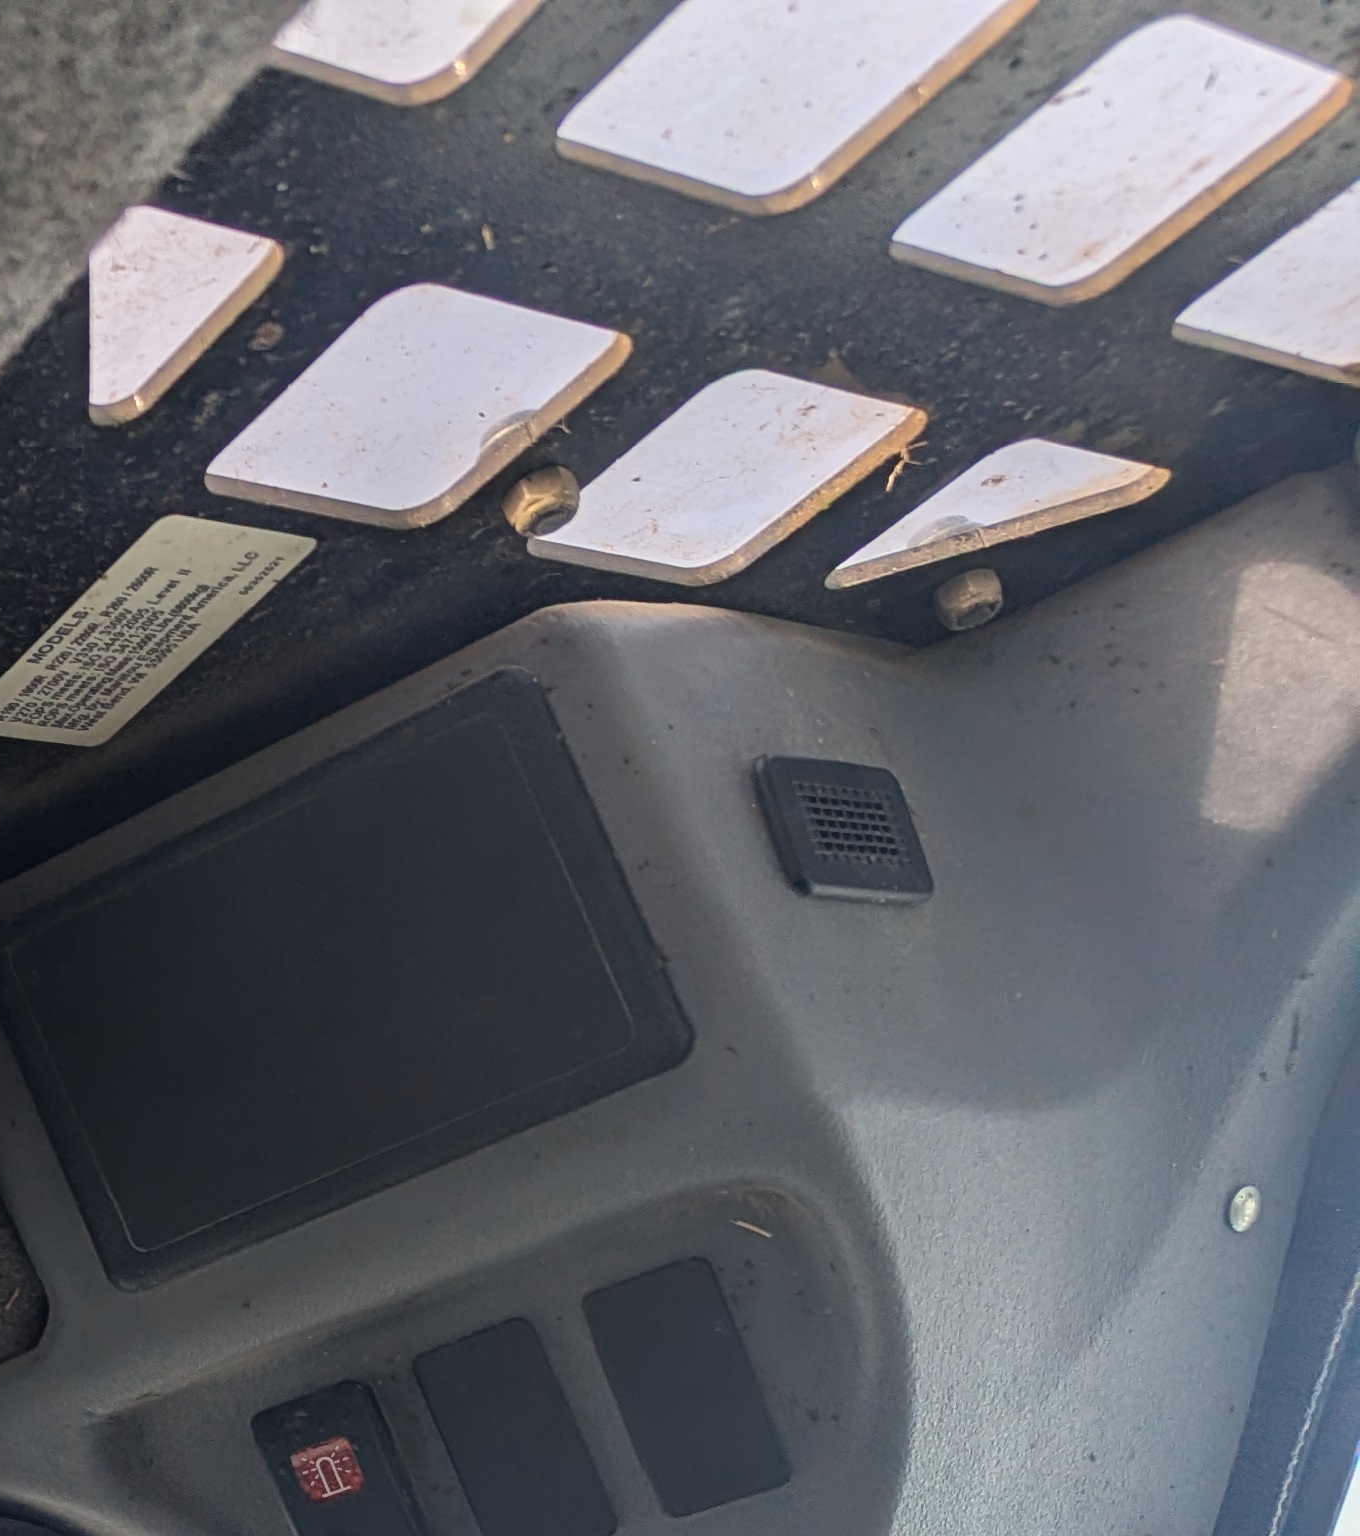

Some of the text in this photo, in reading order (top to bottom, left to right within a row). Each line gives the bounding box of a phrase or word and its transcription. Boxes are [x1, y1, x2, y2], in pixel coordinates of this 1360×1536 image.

[22, 701, 54, 725] FOPS
[78, 654, 102, 670] ISO
[146, 579, 180, 605] Level
[135, 614, 194, 662] Equipment
[231, 551, 259, 572] LLC
[36, 702, 69, 727] ROPS
[93, 655, 117, 672] ISO
[76, 710, 107, 731] West
[171, 622, 201, 642] USA
